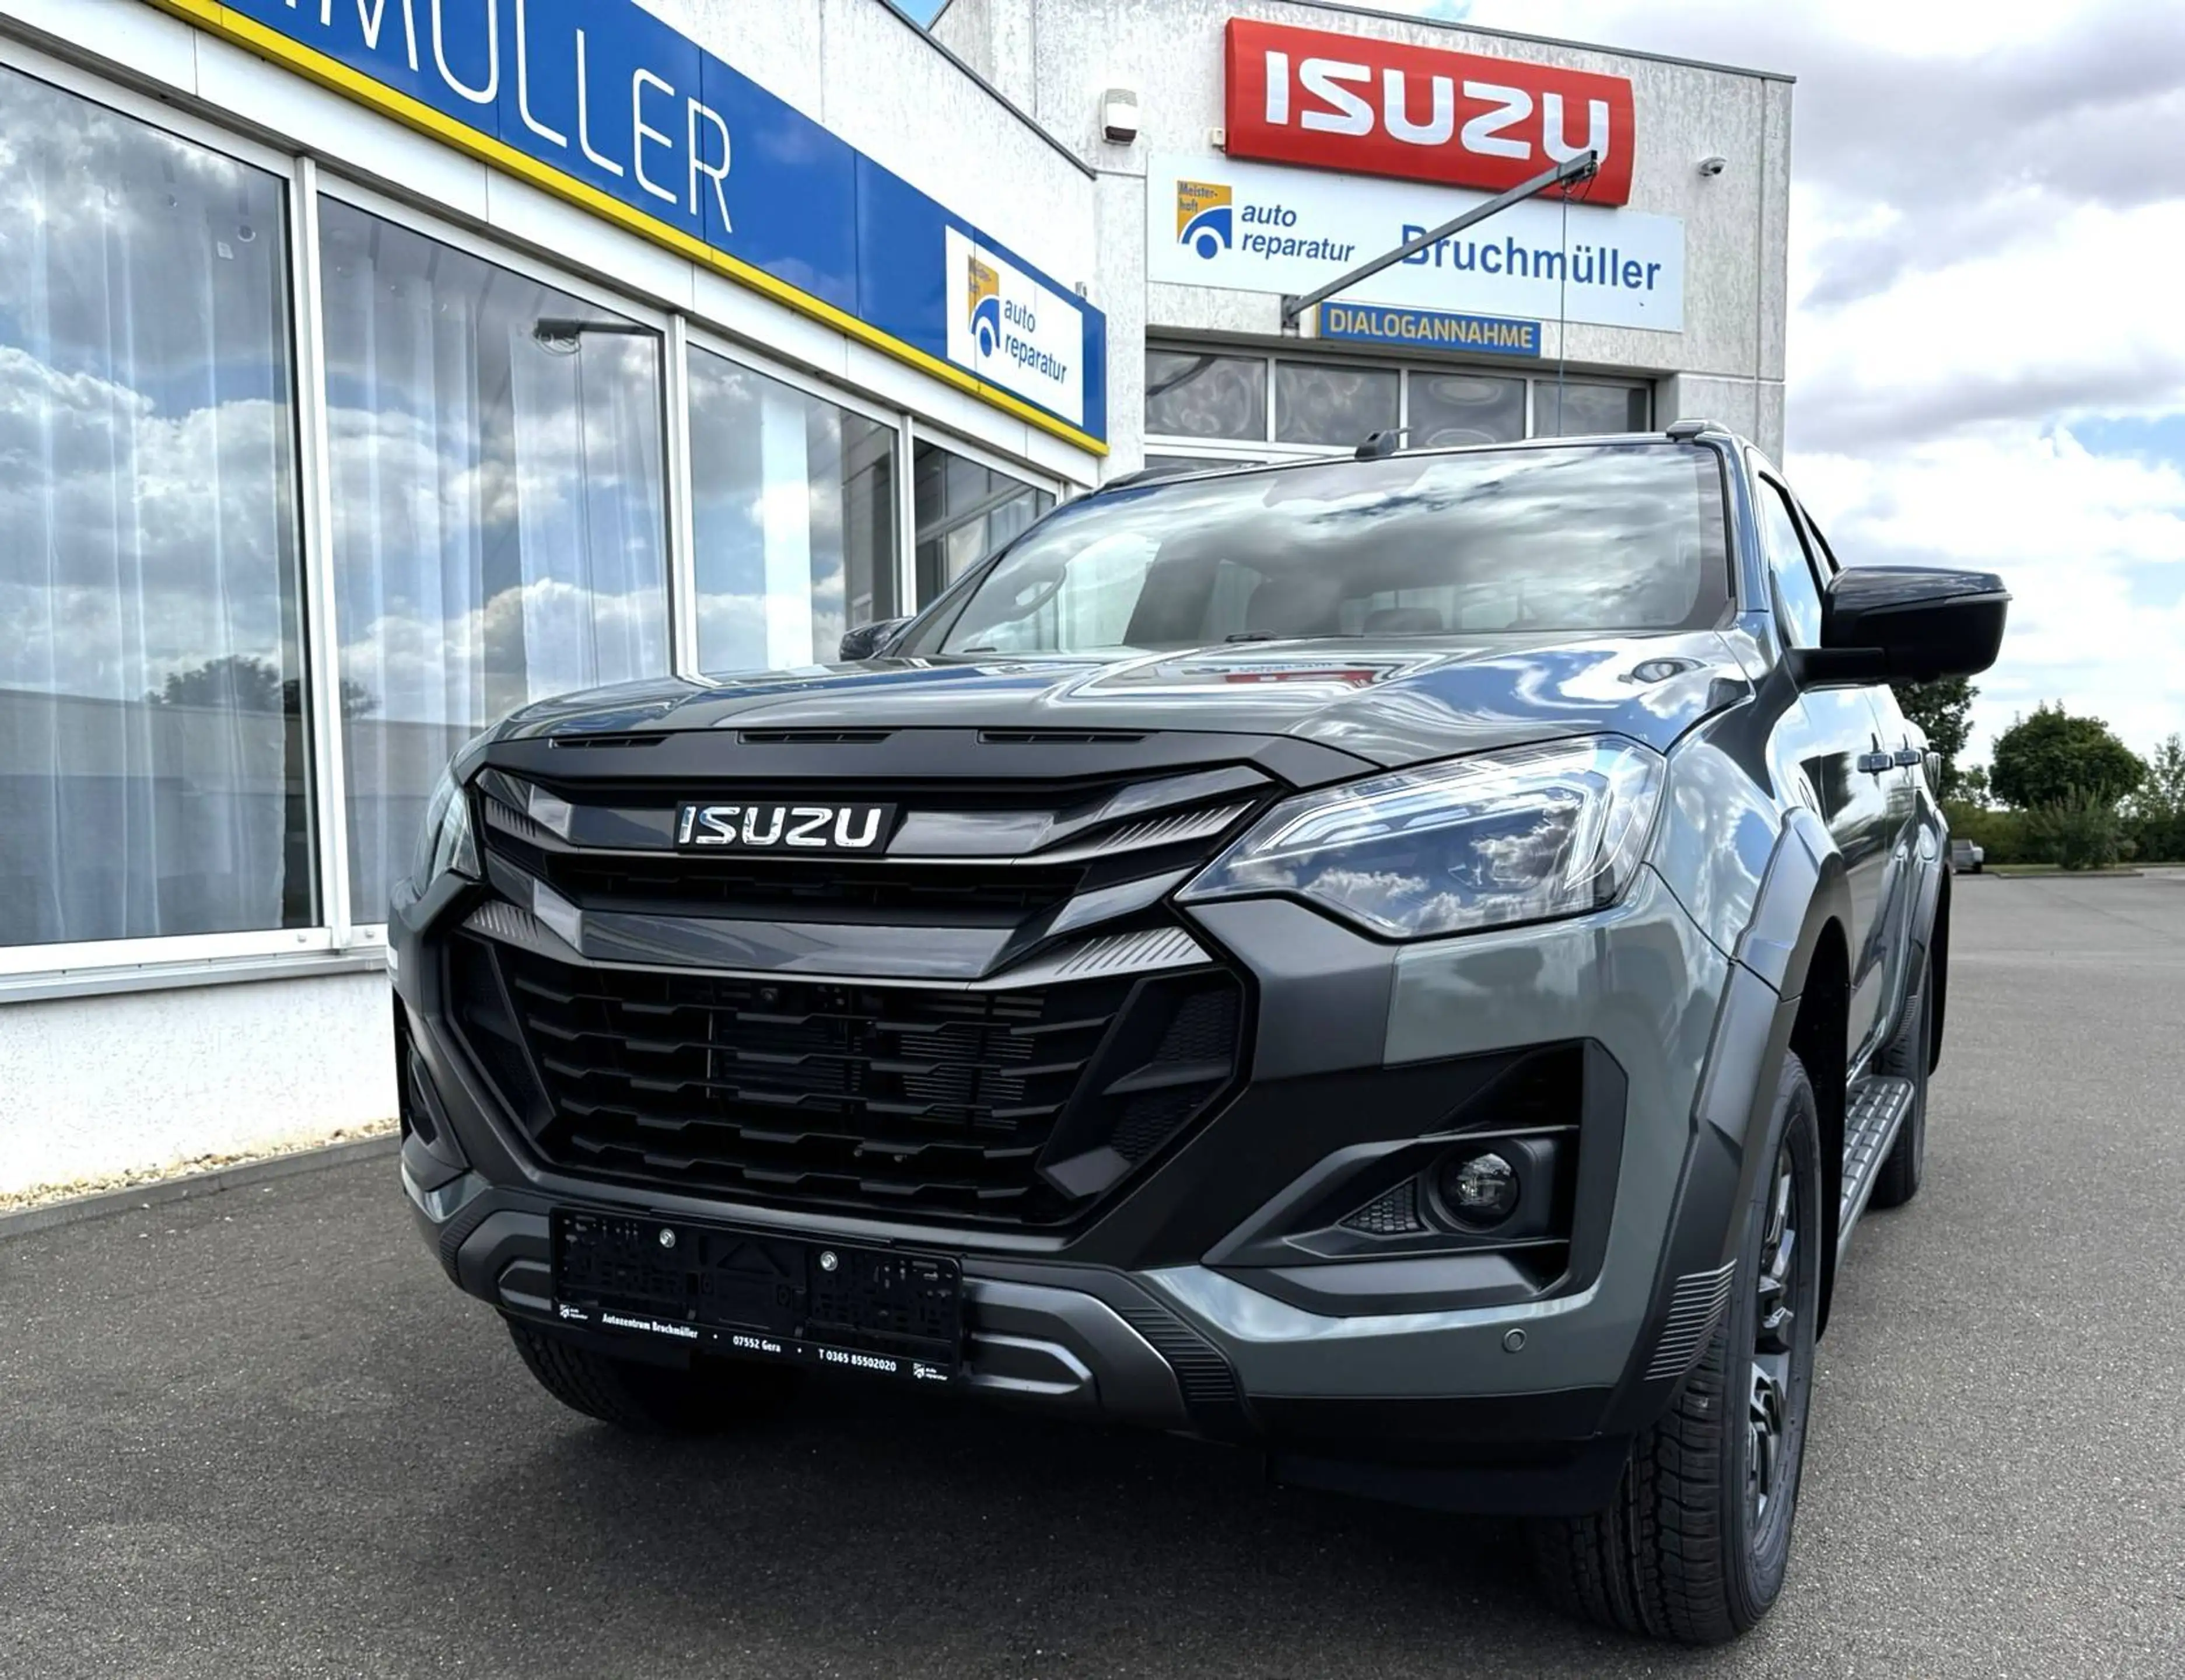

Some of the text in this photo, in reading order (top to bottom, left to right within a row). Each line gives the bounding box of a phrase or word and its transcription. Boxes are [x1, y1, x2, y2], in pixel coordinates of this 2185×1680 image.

[1265, 51, 1609, 169] ISUZU
[1241, 205, 1297, 228] auto
[1241, 233, 1355, 262] reparatur
[1402, 224, 1661, 290] Bruchmüller
[1004, 299, 1036, 334] auto
[1329, 308, 1534, 349] DIALOGANNAHME
[1004, 334, 1067, 385] reparatur
[678, 806, 881, 848] ISUZU
[733, 1335, 760, 1349] 07552
[761, 1340, 781, 1353] Gera
[818, 1348, 825, 1360] T
[826, 1350, 849, 1364] 0365
[851, 1354, 897, 1372] 85502020
